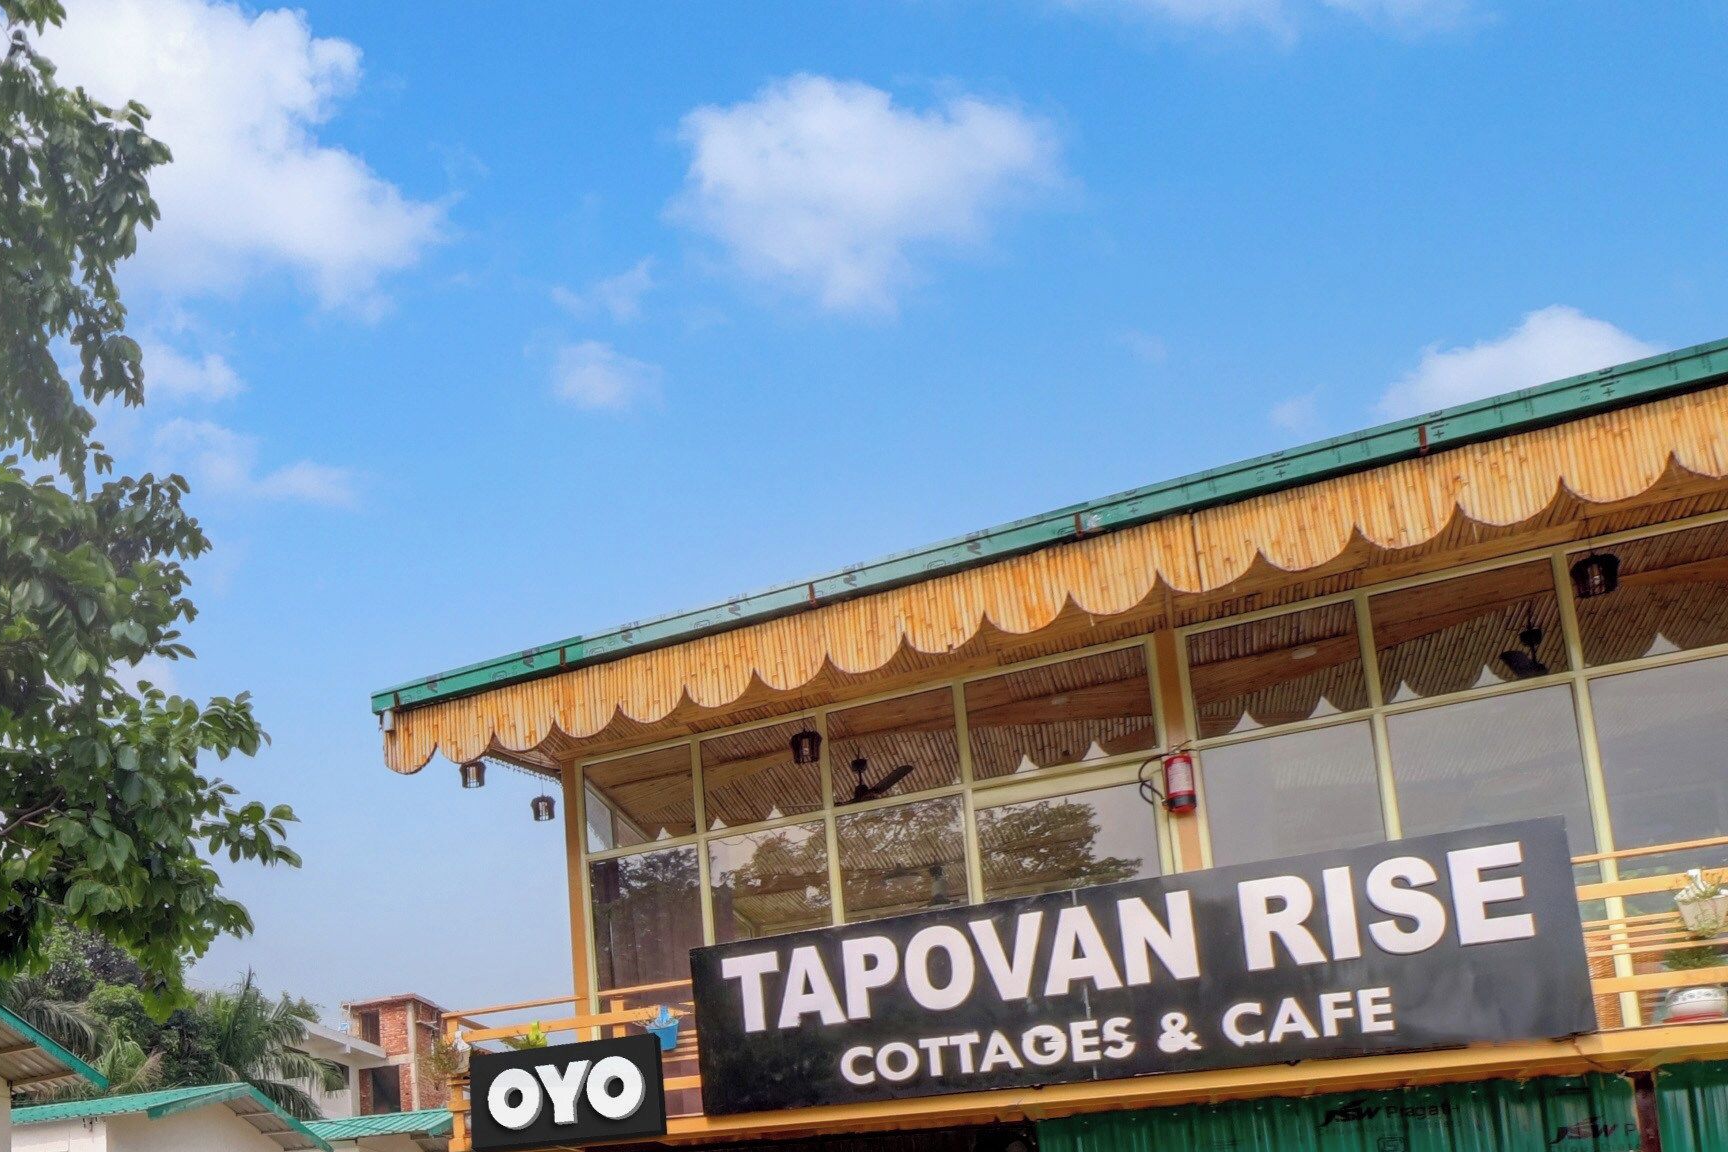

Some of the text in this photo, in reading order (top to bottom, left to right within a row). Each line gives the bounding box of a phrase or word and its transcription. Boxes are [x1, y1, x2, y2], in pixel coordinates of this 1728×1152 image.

[721, 840, 1537, 1033] TAPOVAN RISE
[840, 986, 1395, 1085] COTTAGES & CAFE
[487, 1055, 646, 1130] OYO
